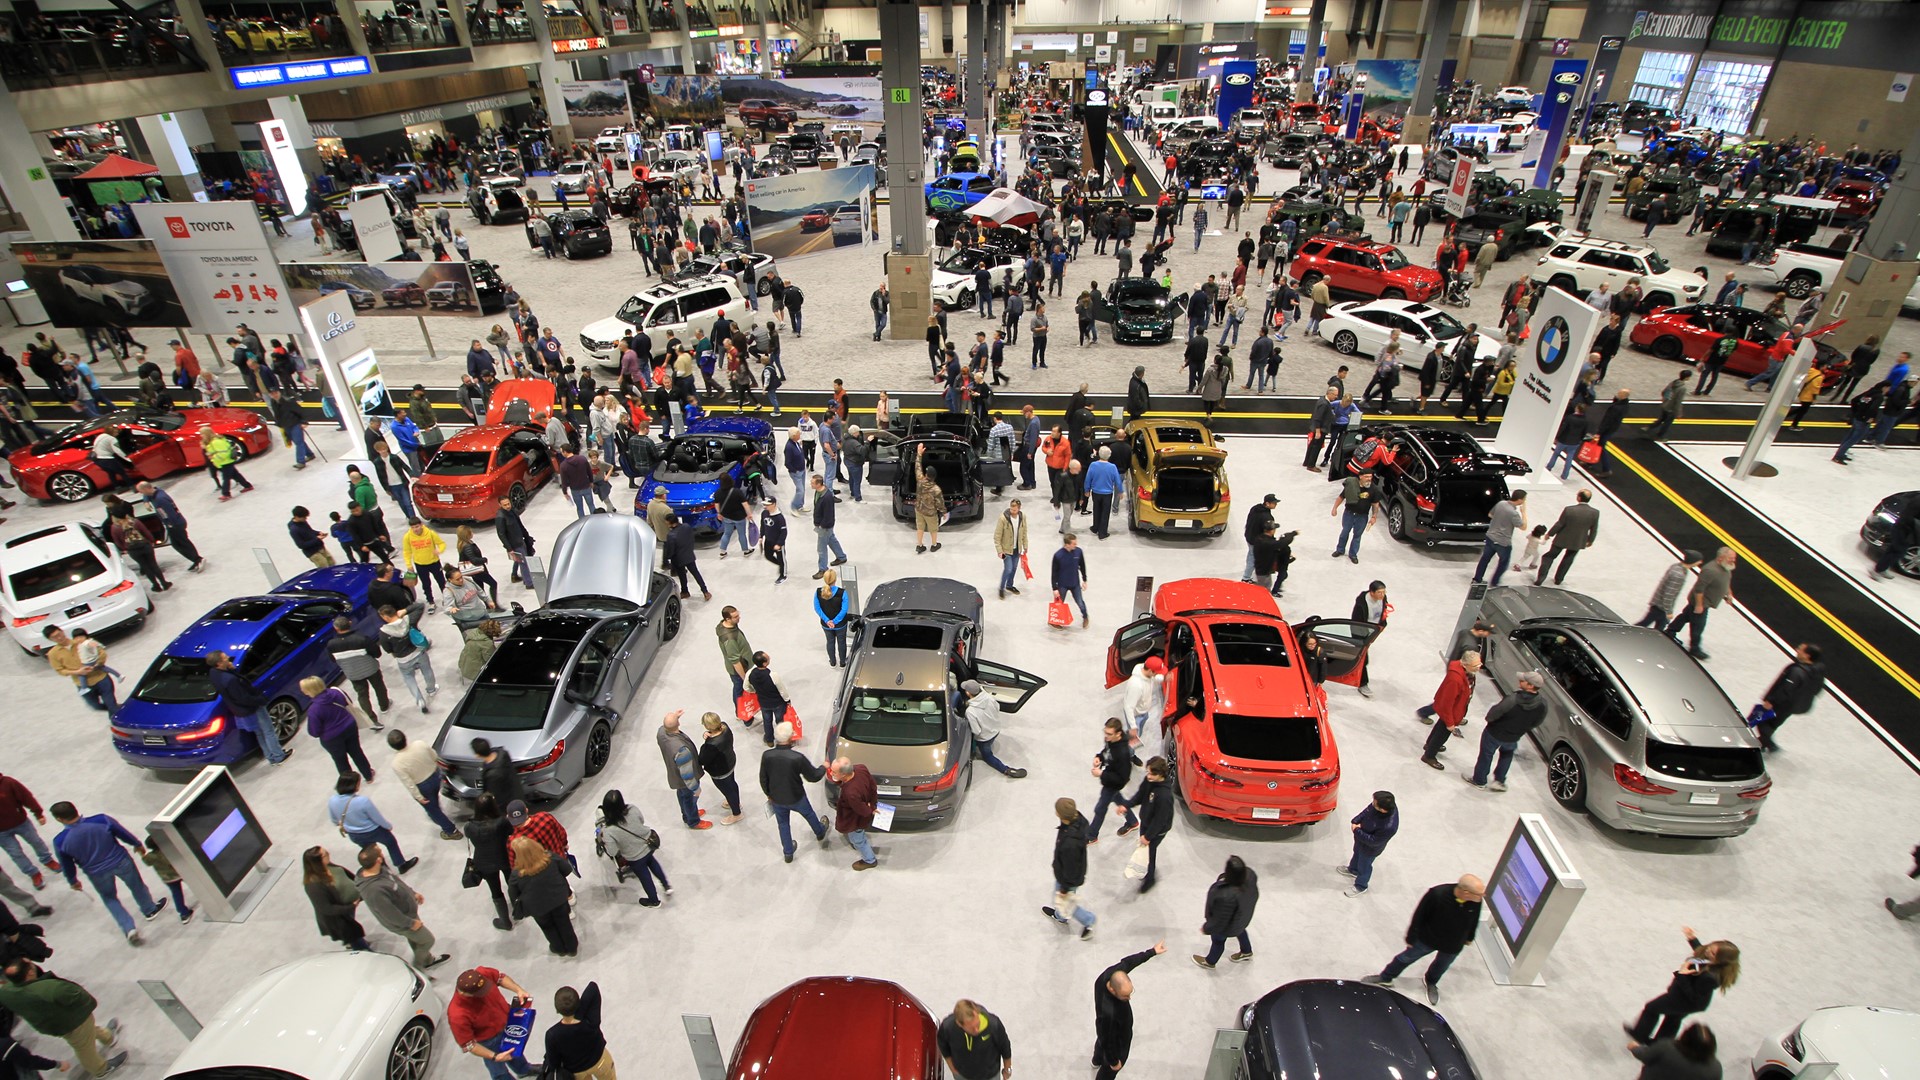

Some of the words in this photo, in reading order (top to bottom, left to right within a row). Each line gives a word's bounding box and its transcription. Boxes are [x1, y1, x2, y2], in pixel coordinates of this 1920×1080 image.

[1643, 12, 1714, 40] CENTURYLINK
[1713, 15, 1746, 41] FIELD
[1744, 15, 1789, 45] EVENT
[1788, 17, 1848, 49] CENTER
[466, 96, 508, 112] STARBUCKS
[896, 90, 906, 102] 8L
[401, 110, 415, 125] EAT
[419, 108, 443, 122] DRINK
[189, 221, 235, 232] TOYOTA
[321, 320, 356, 341] LEXUS
[1523, 378, 1536, 393] Driving
[1536, 387, 1551, 404] Machine
[1536, 377, 1551, 393] Ultimate
